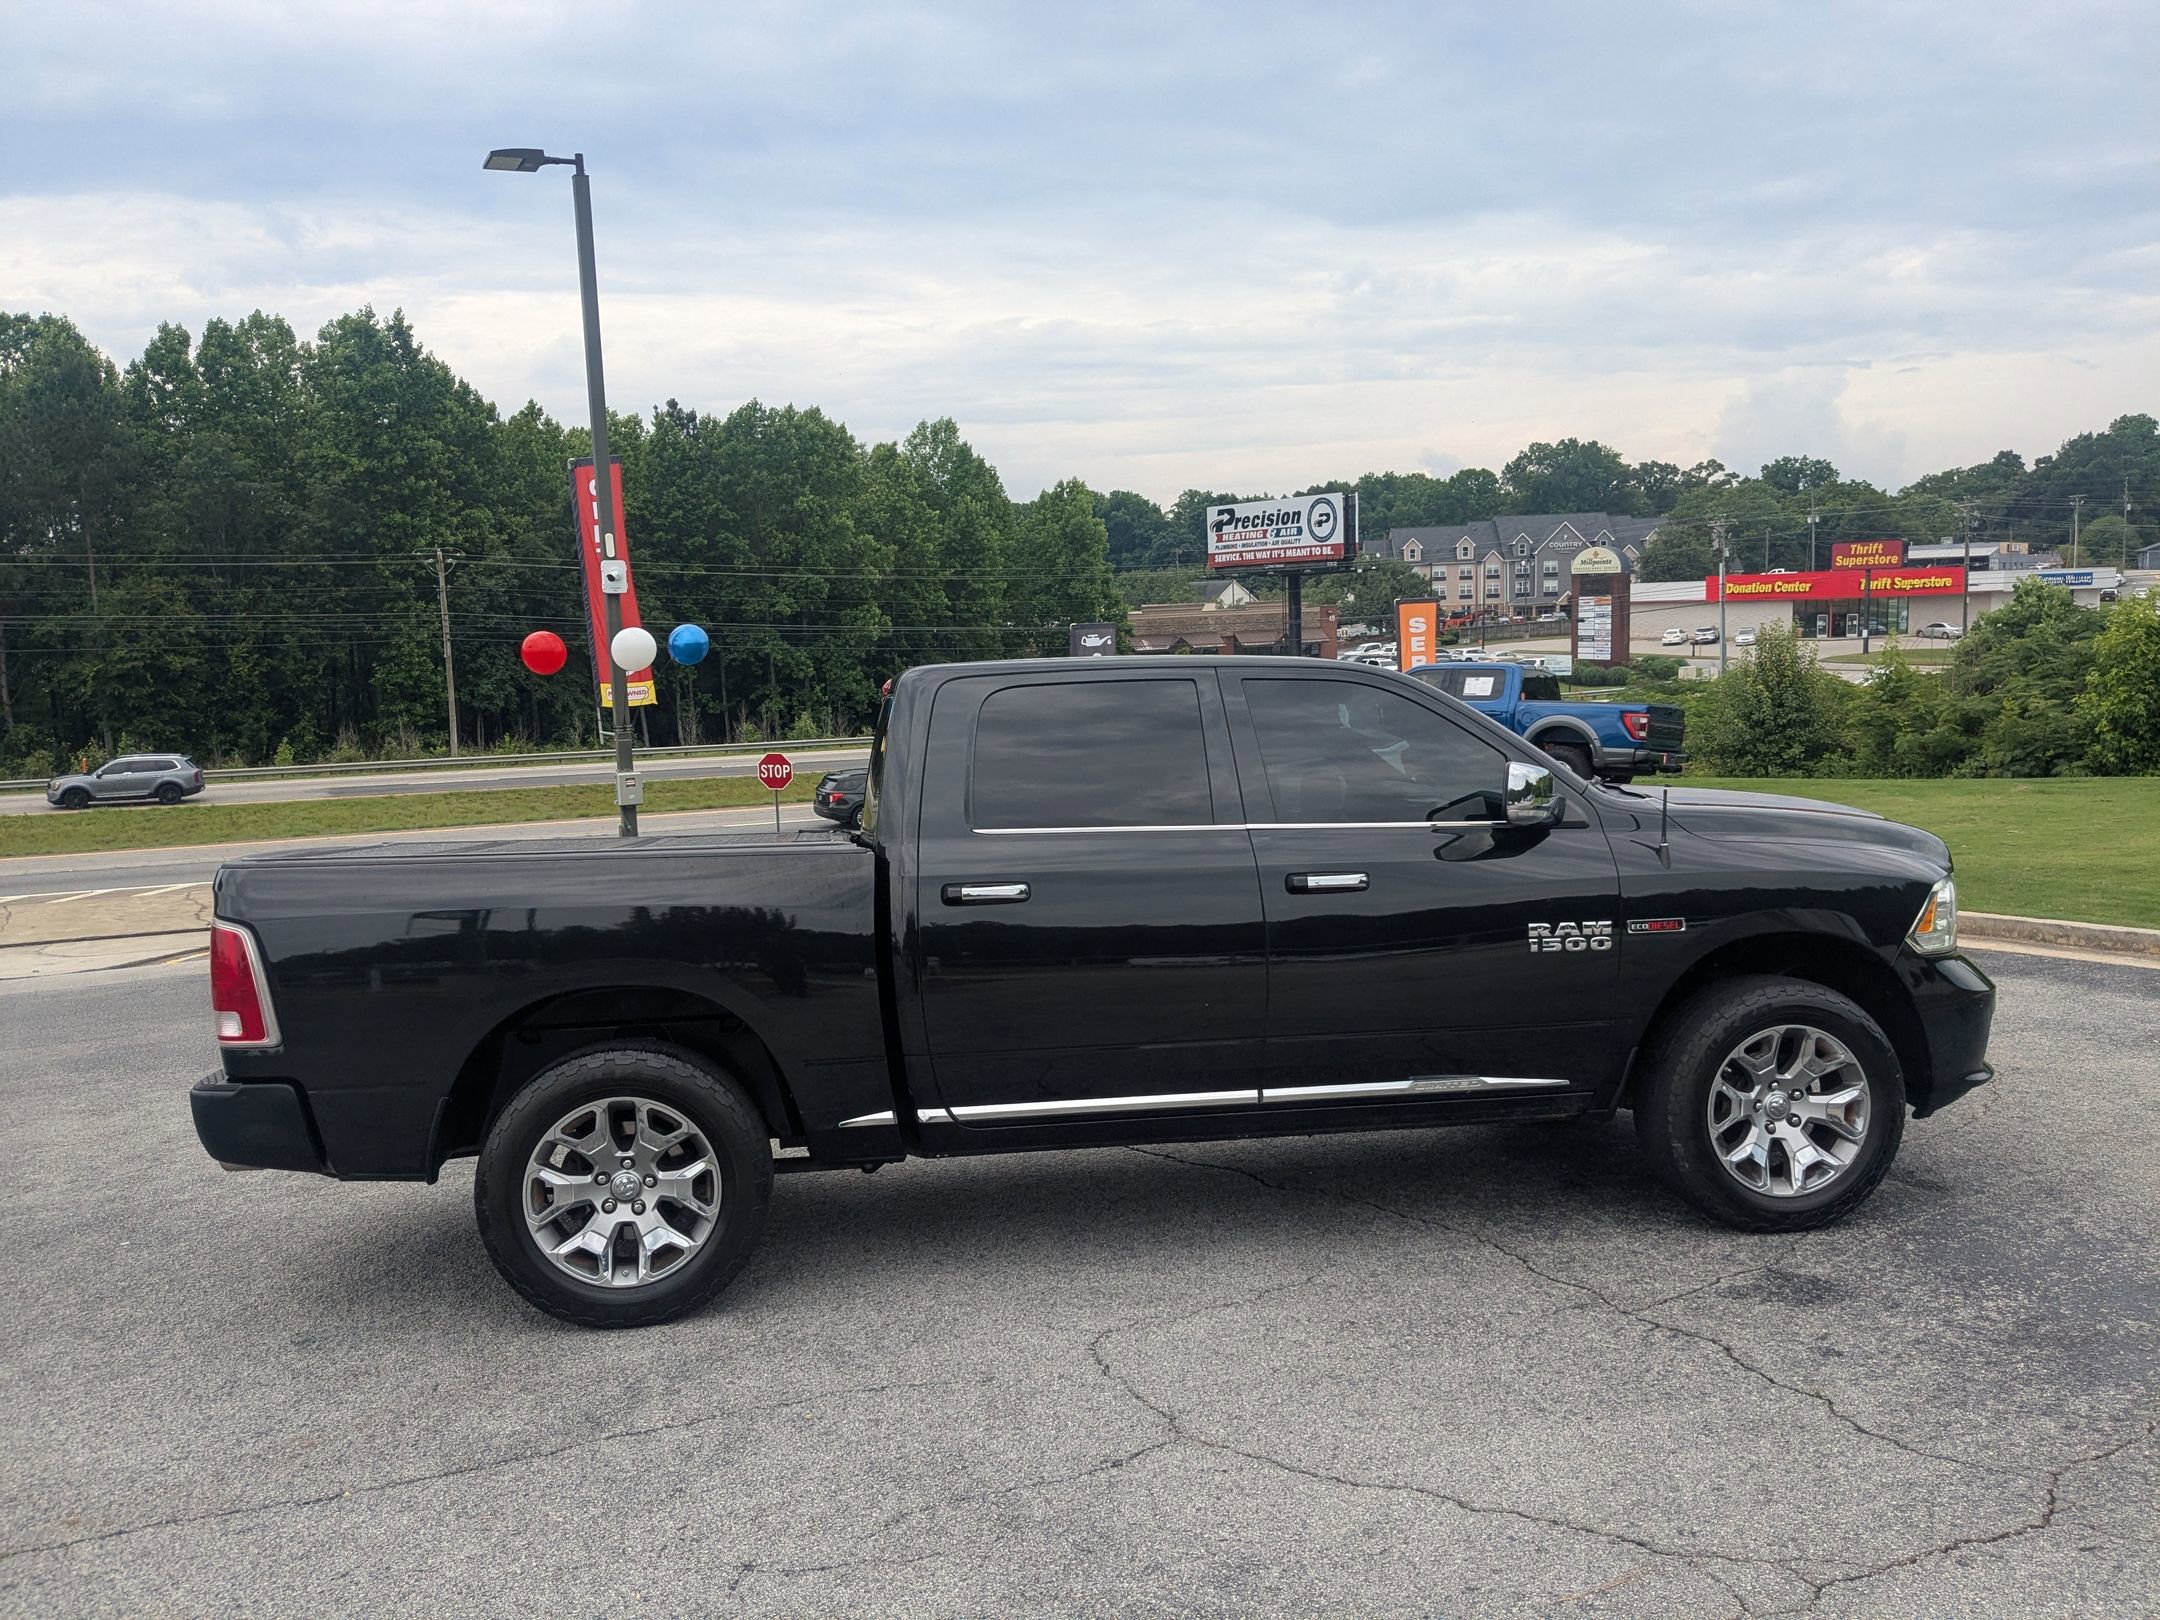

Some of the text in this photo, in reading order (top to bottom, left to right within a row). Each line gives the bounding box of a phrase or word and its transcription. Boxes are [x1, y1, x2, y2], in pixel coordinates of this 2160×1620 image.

[1210, 508, 1302, 532] Precision
[1222, 530, 1263, 541] HEATING
[1280, 527, 1298, 536] AIR
[1215, 543, 1238, 551] PLUMBING
[1241, 540, 1268, 549] INSULATION
[1281, 538, 1301, 546] QUALITY
[1850, 543, 1884, 555] Thrift
[1215, 552, 1242, 562] SERVICE.
[1242, 552, 1255, 560] THE
[1255, 550, 1271, 559] WAY
[1286, 547, 1312, 557] MEANT
[1312, 547, 1321, 555] TO
[1322, 546, 1334, 555] BE.
[1835, 554, 1899, 568] Superstore
[1726, 581, 1812, 594] Donation Center
[1860, 576, 1952, 590] Trift Superstore
[761, 764, 790, 778] STOP
[1528, 920, 1612, 937] RAM
[1528, 936, 1612, 952] 1500
